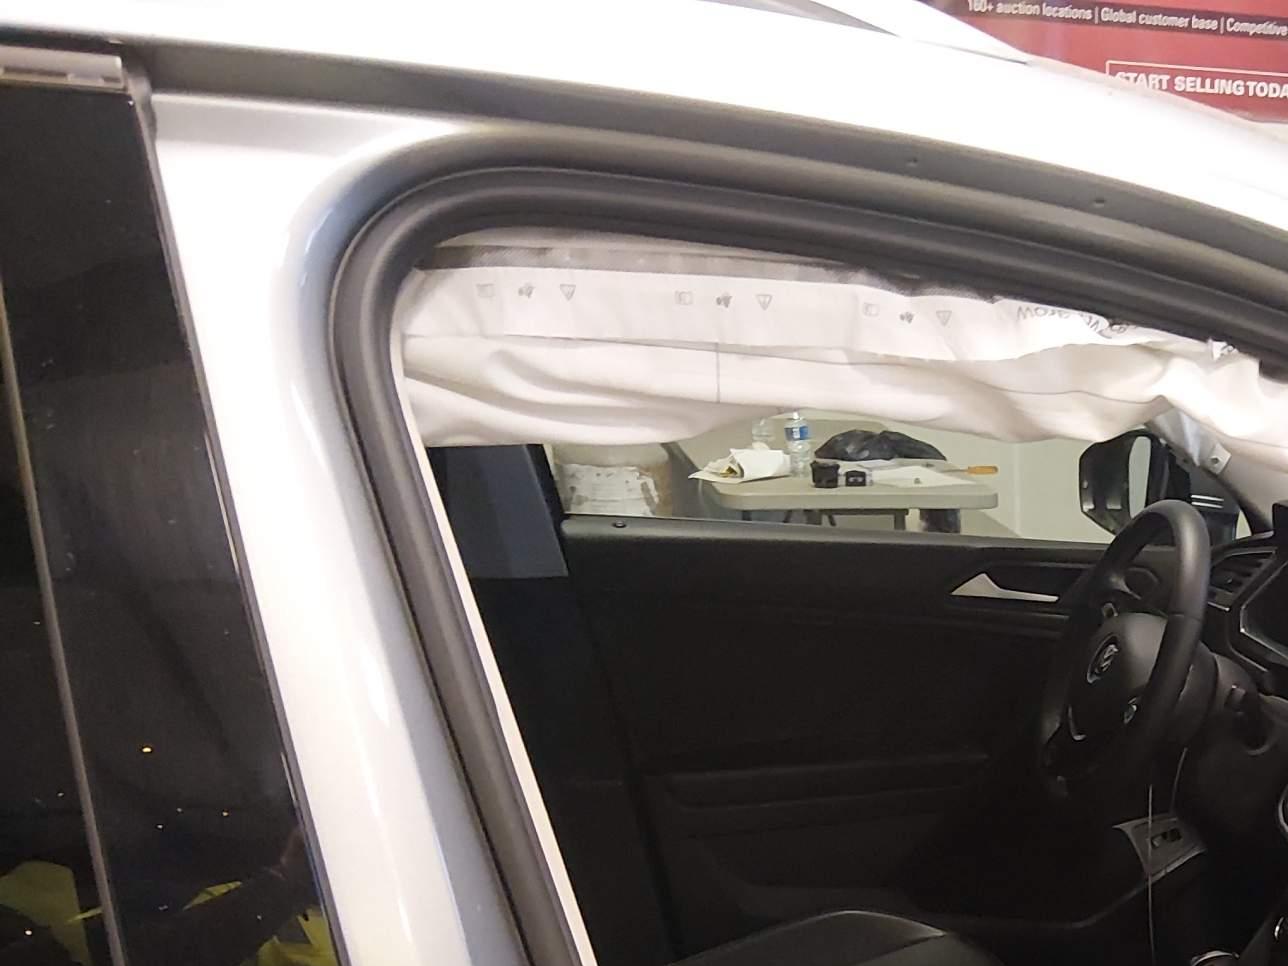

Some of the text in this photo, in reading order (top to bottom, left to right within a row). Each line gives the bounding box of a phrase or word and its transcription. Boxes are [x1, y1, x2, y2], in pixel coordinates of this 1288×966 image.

[996, 1, 1040, 15] auction
[1042, 4, 1092, 20] locations
[1101, 9, 1137, 23] Global
[1138, 14, 1189, 28] customer
[1191, 15, 1217, 30] base
[1226, 18, 1287, 36] Competitive
[1174, 76, 1244, 95] SELLING
